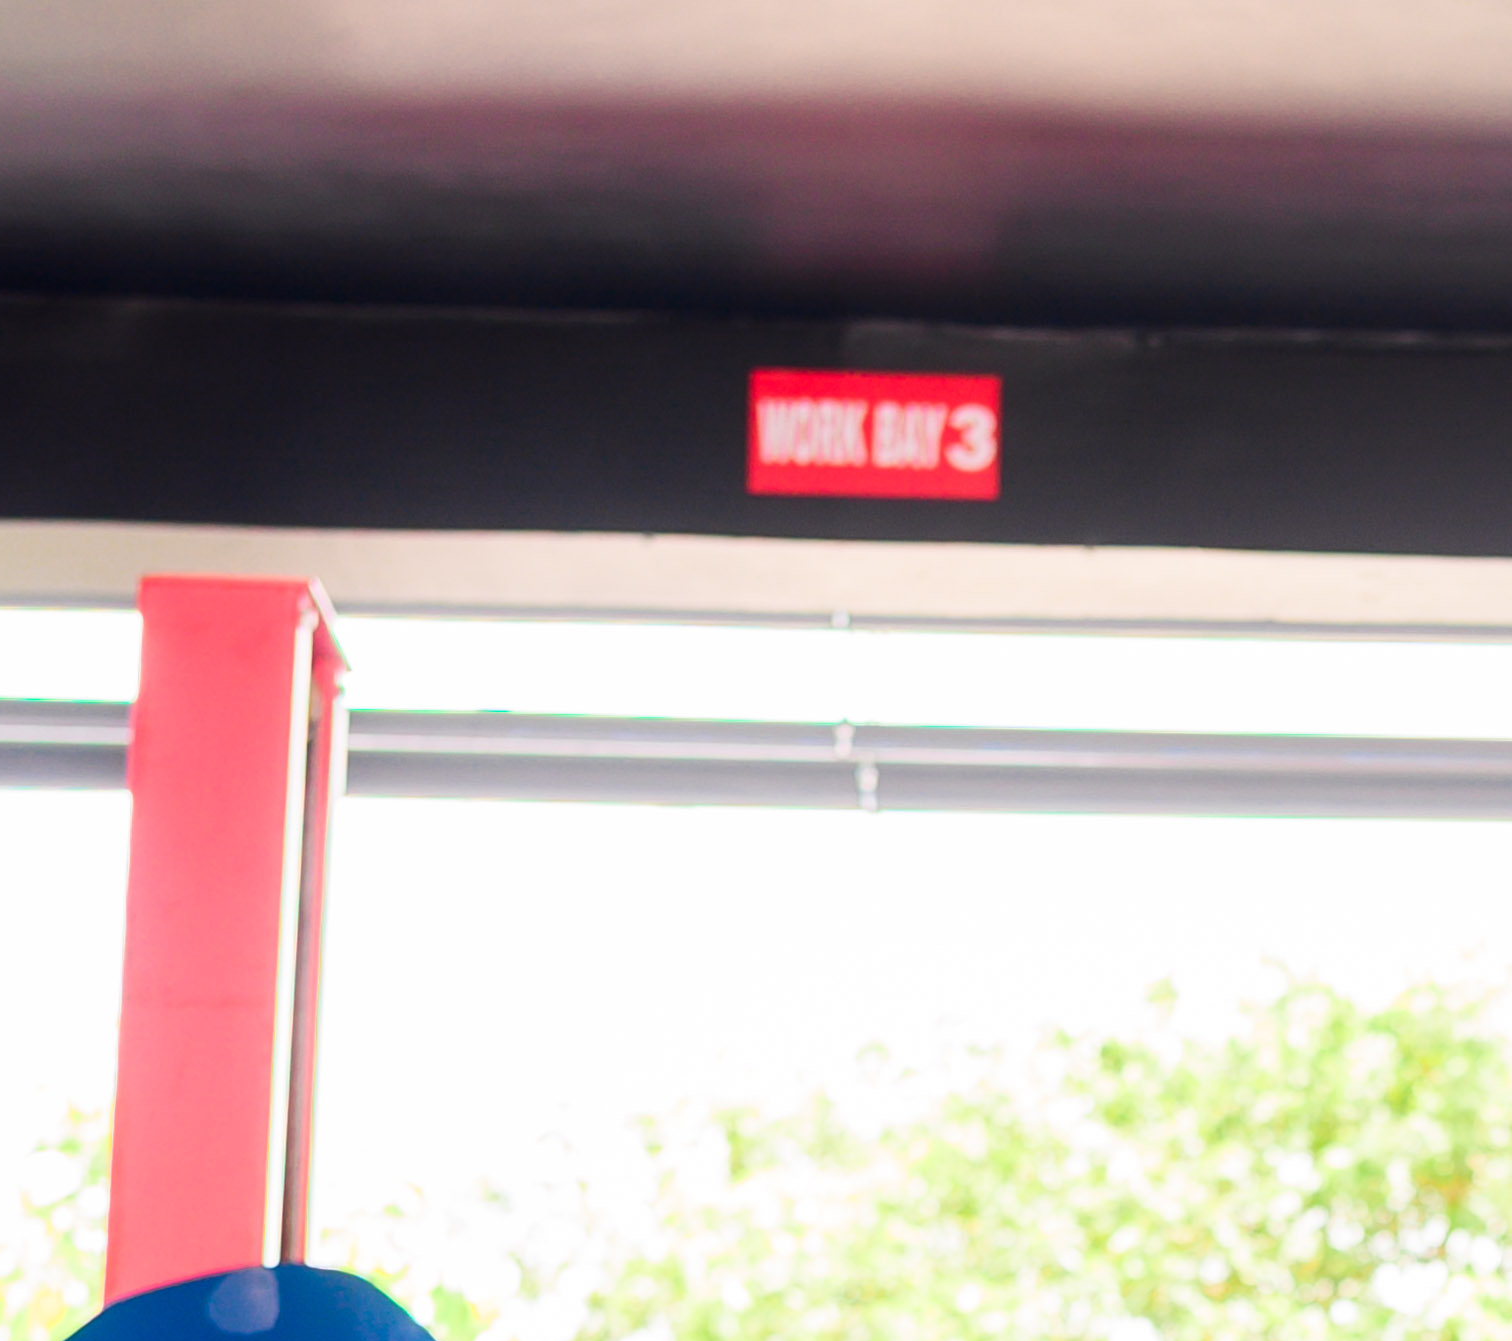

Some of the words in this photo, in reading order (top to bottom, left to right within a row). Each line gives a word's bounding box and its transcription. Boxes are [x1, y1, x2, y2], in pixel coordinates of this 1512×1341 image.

[756, 397, 869, 467] WORK
[871, 400, 949, 470] BAY
[944, 403, 998, 473] 3
